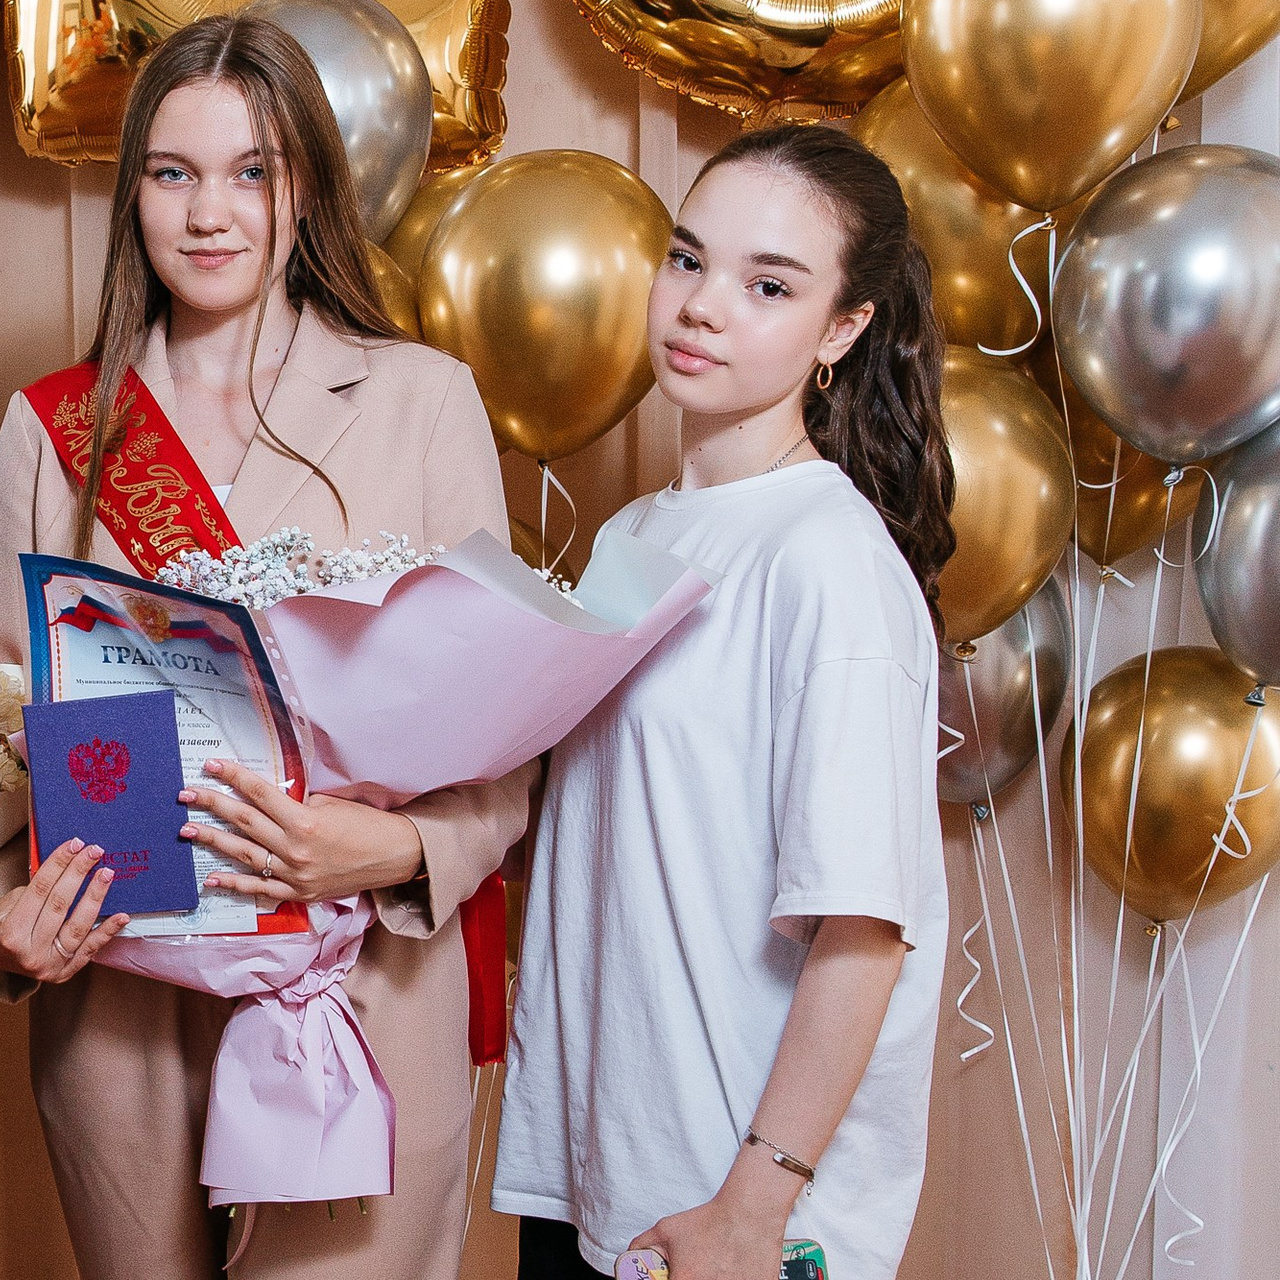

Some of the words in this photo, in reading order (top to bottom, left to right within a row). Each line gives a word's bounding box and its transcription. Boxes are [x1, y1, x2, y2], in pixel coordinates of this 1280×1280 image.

[101, 644, 222, 677] ГРАМОТА
[179, 738, 223, 748] изавету
[102, 849, 150, 865] ЕСТАТ
